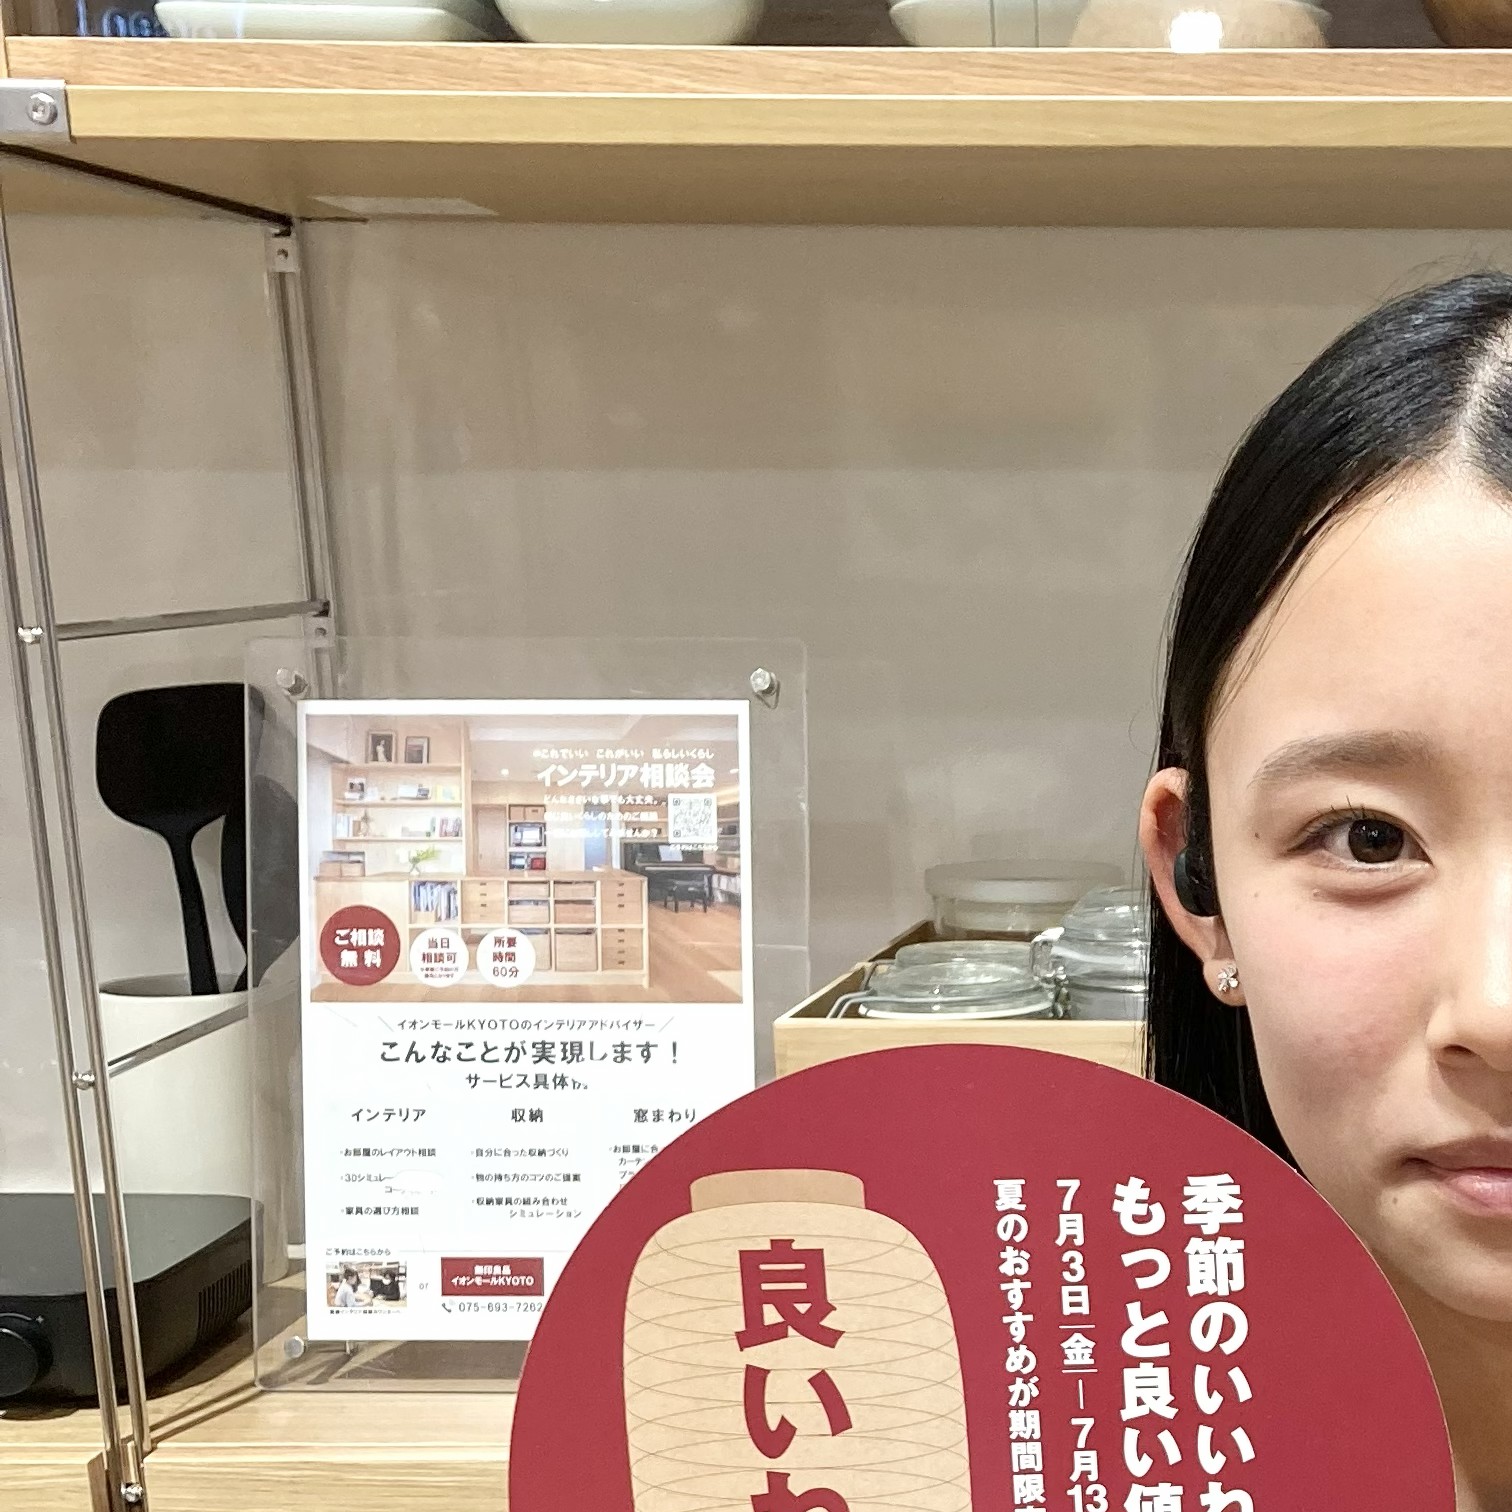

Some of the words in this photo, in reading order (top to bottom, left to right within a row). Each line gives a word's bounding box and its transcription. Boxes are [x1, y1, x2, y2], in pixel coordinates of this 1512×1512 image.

[537, 762, 716, 788] インテリア相談会
[334, 928, 385, 947] ご相談
[428, 937, 451, 949] 当日
[492, 951, 517, 963] 時間
[492, 966, 520, 978] 60分
[350, 1108, 427, 1123] インテリア
[510, 1107, 545, 1123] 収納
[633, 1108, 697, 1124] 窓まわり
[509, 1209, 583, 1219] シミュレーション
[418, 1282, 429, 1291] or
